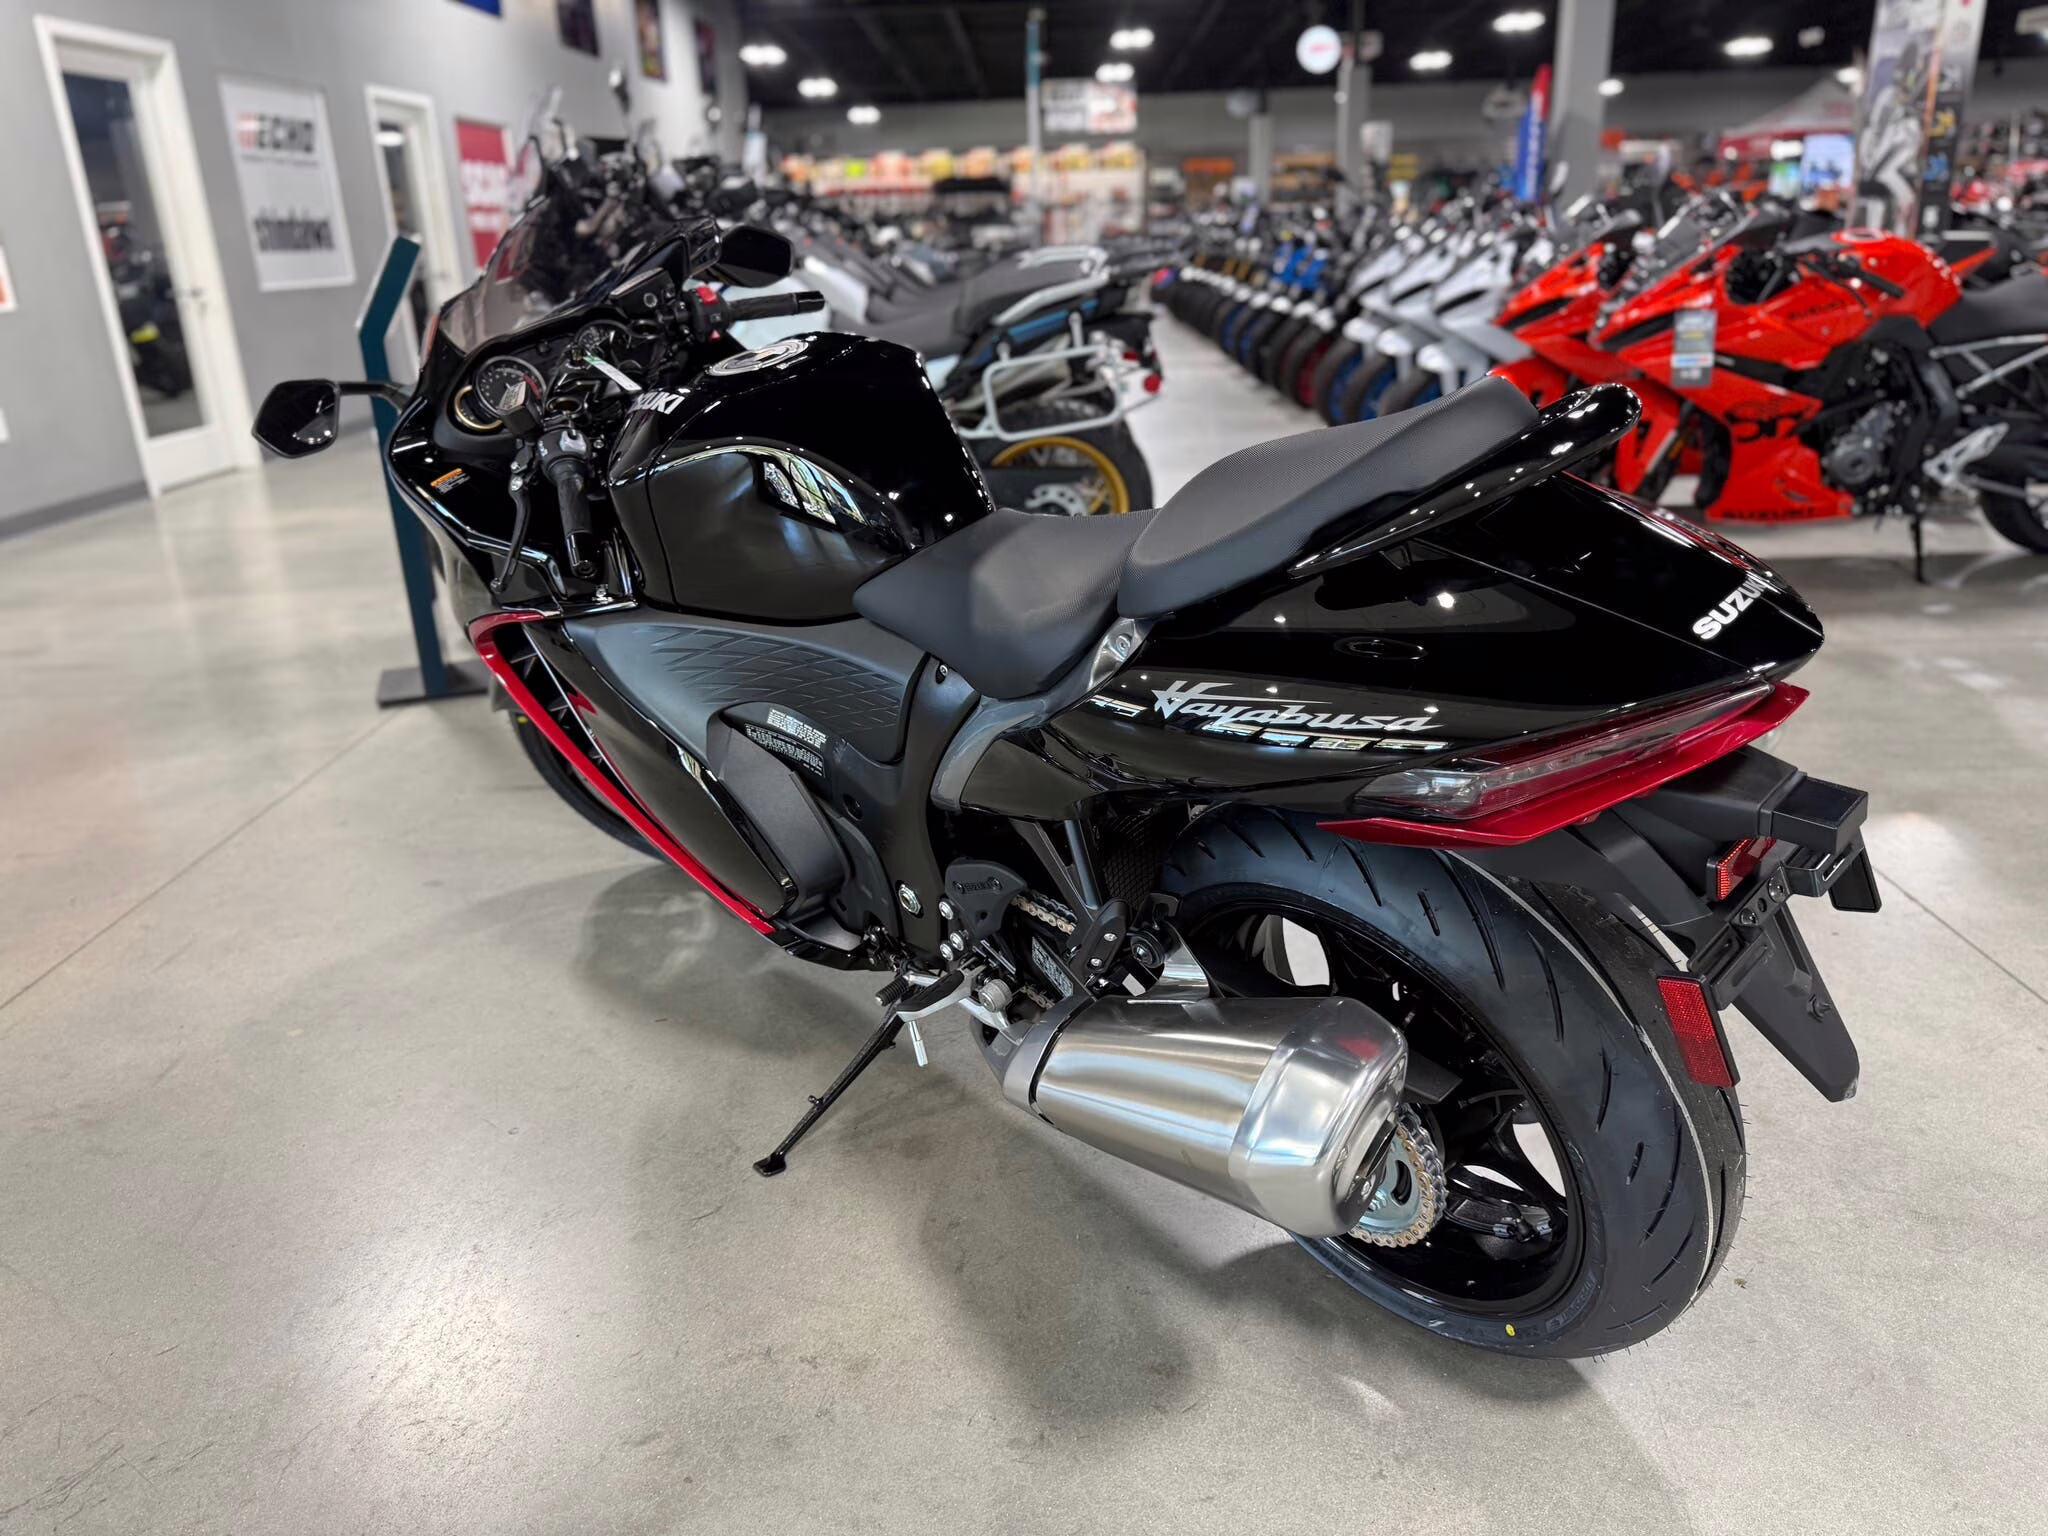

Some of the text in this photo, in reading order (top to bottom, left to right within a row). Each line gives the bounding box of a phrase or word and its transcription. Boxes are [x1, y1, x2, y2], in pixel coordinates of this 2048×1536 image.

[257, 113, 316, 154] ECHO
[1692, 574, 1767, 640] SUZUK
[1150, 680, 1445, 734] Hayabusa
